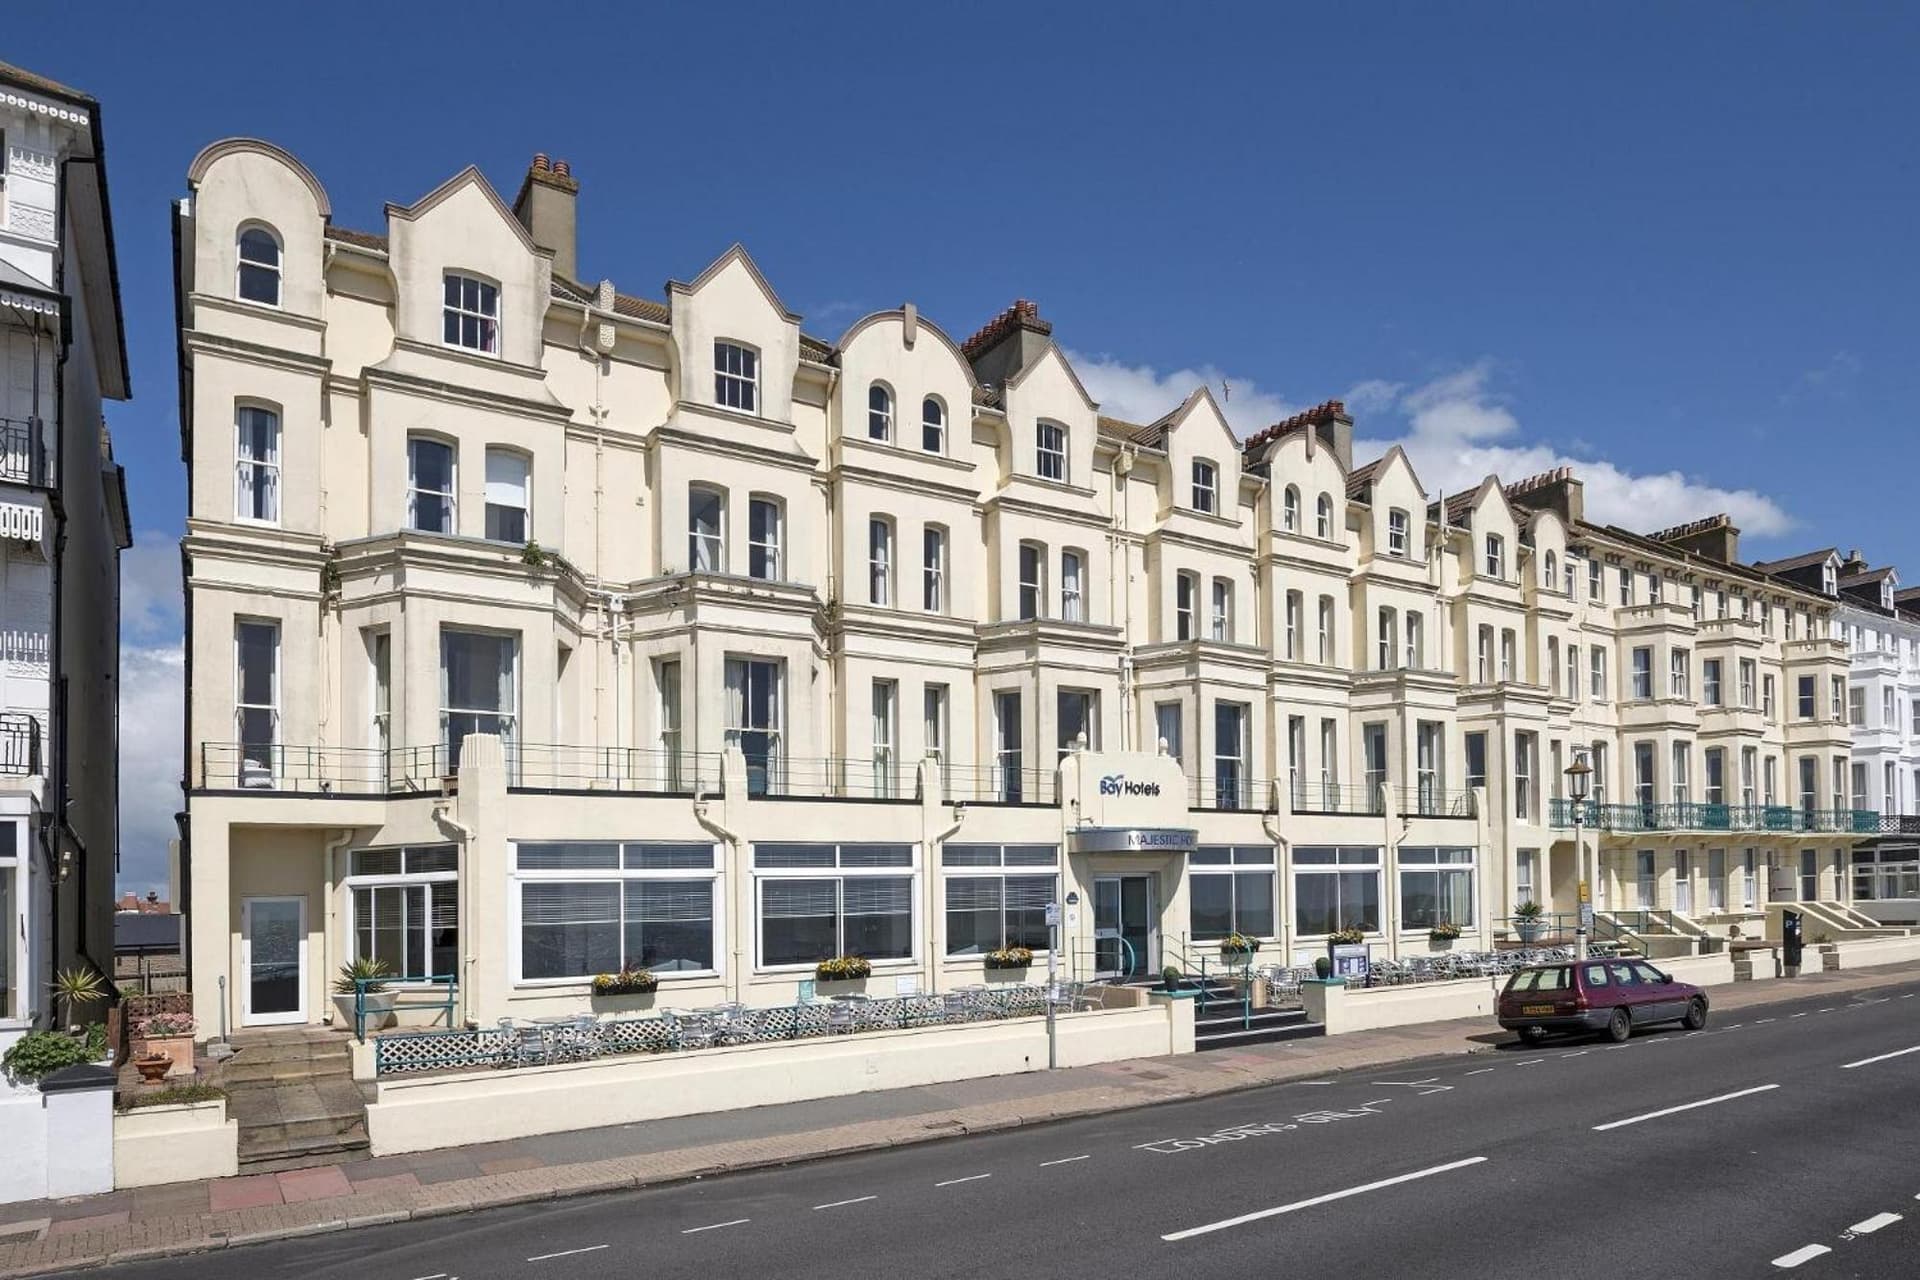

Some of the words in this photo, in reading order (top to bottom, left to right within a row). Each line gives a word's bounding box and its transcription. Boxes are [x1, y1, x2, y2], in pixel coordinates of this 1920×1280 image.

[1100, 780, 1123, 798] Bay
[1125, 781, 1160, 797] Hotels
[1128, 834, 1179, 846] MAJESTIC
